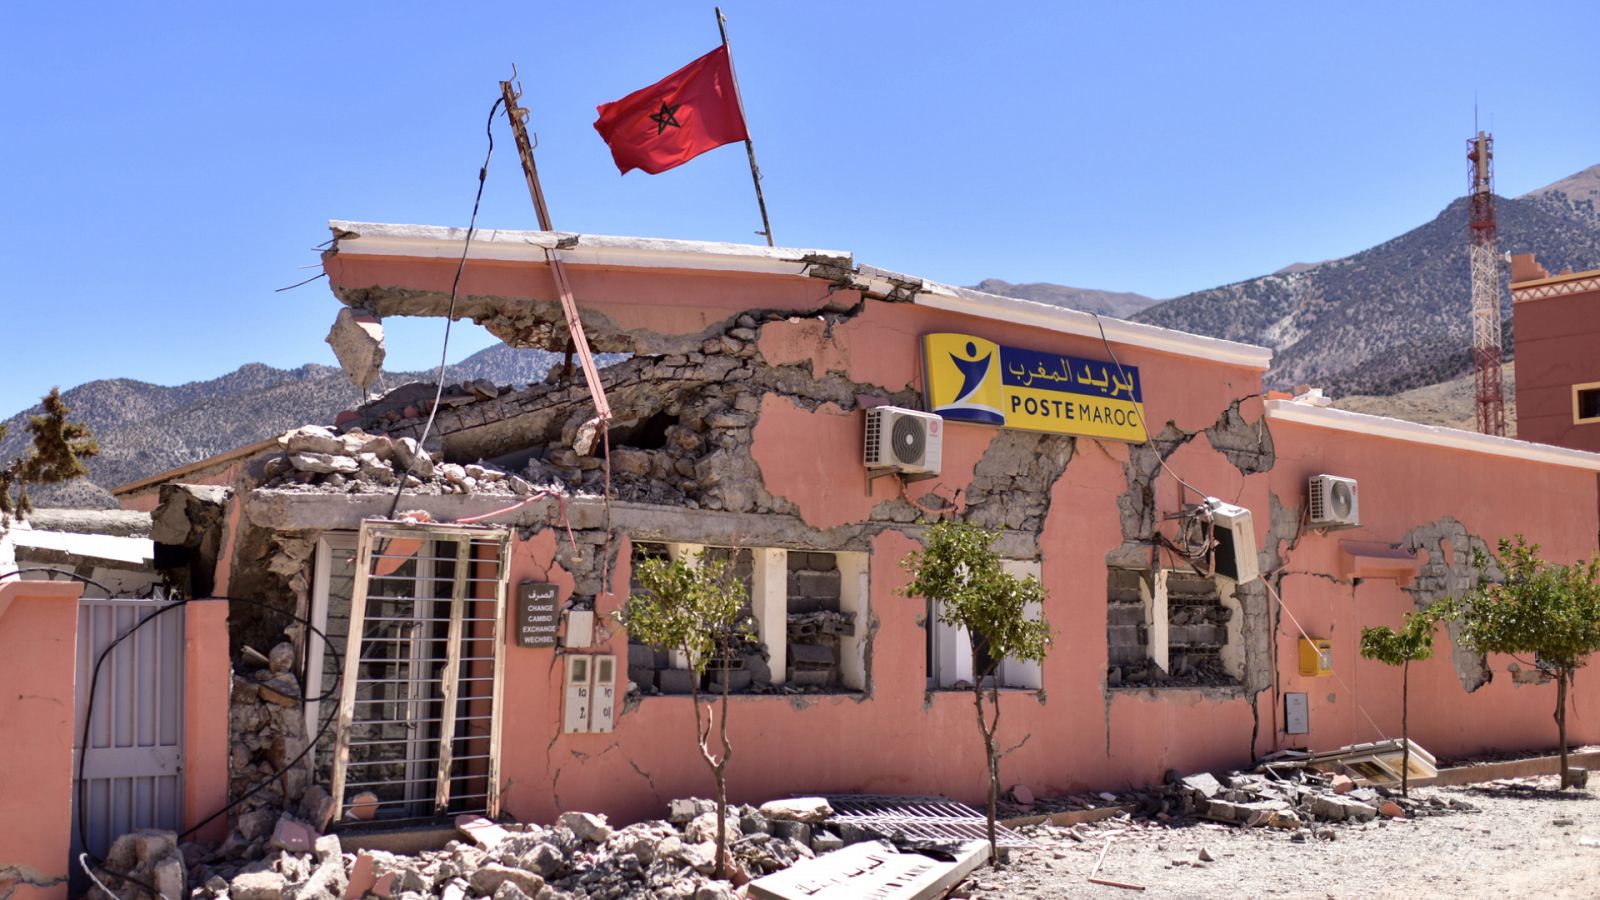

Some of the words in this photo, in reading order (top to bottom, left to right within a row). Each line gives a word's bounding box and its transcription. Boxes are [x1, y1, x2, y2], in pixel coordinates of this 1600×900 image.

[1009, 358, 1073, 386] المغرب
[1077, 364, 1134, 397] بريد
[528, 591, 555, 601] الصرف
[528, 604, 553, 612] CHANGE
[523, 625, 557, 633] EXCHANGE
[524, 635, 554, 643] WECHSEL
